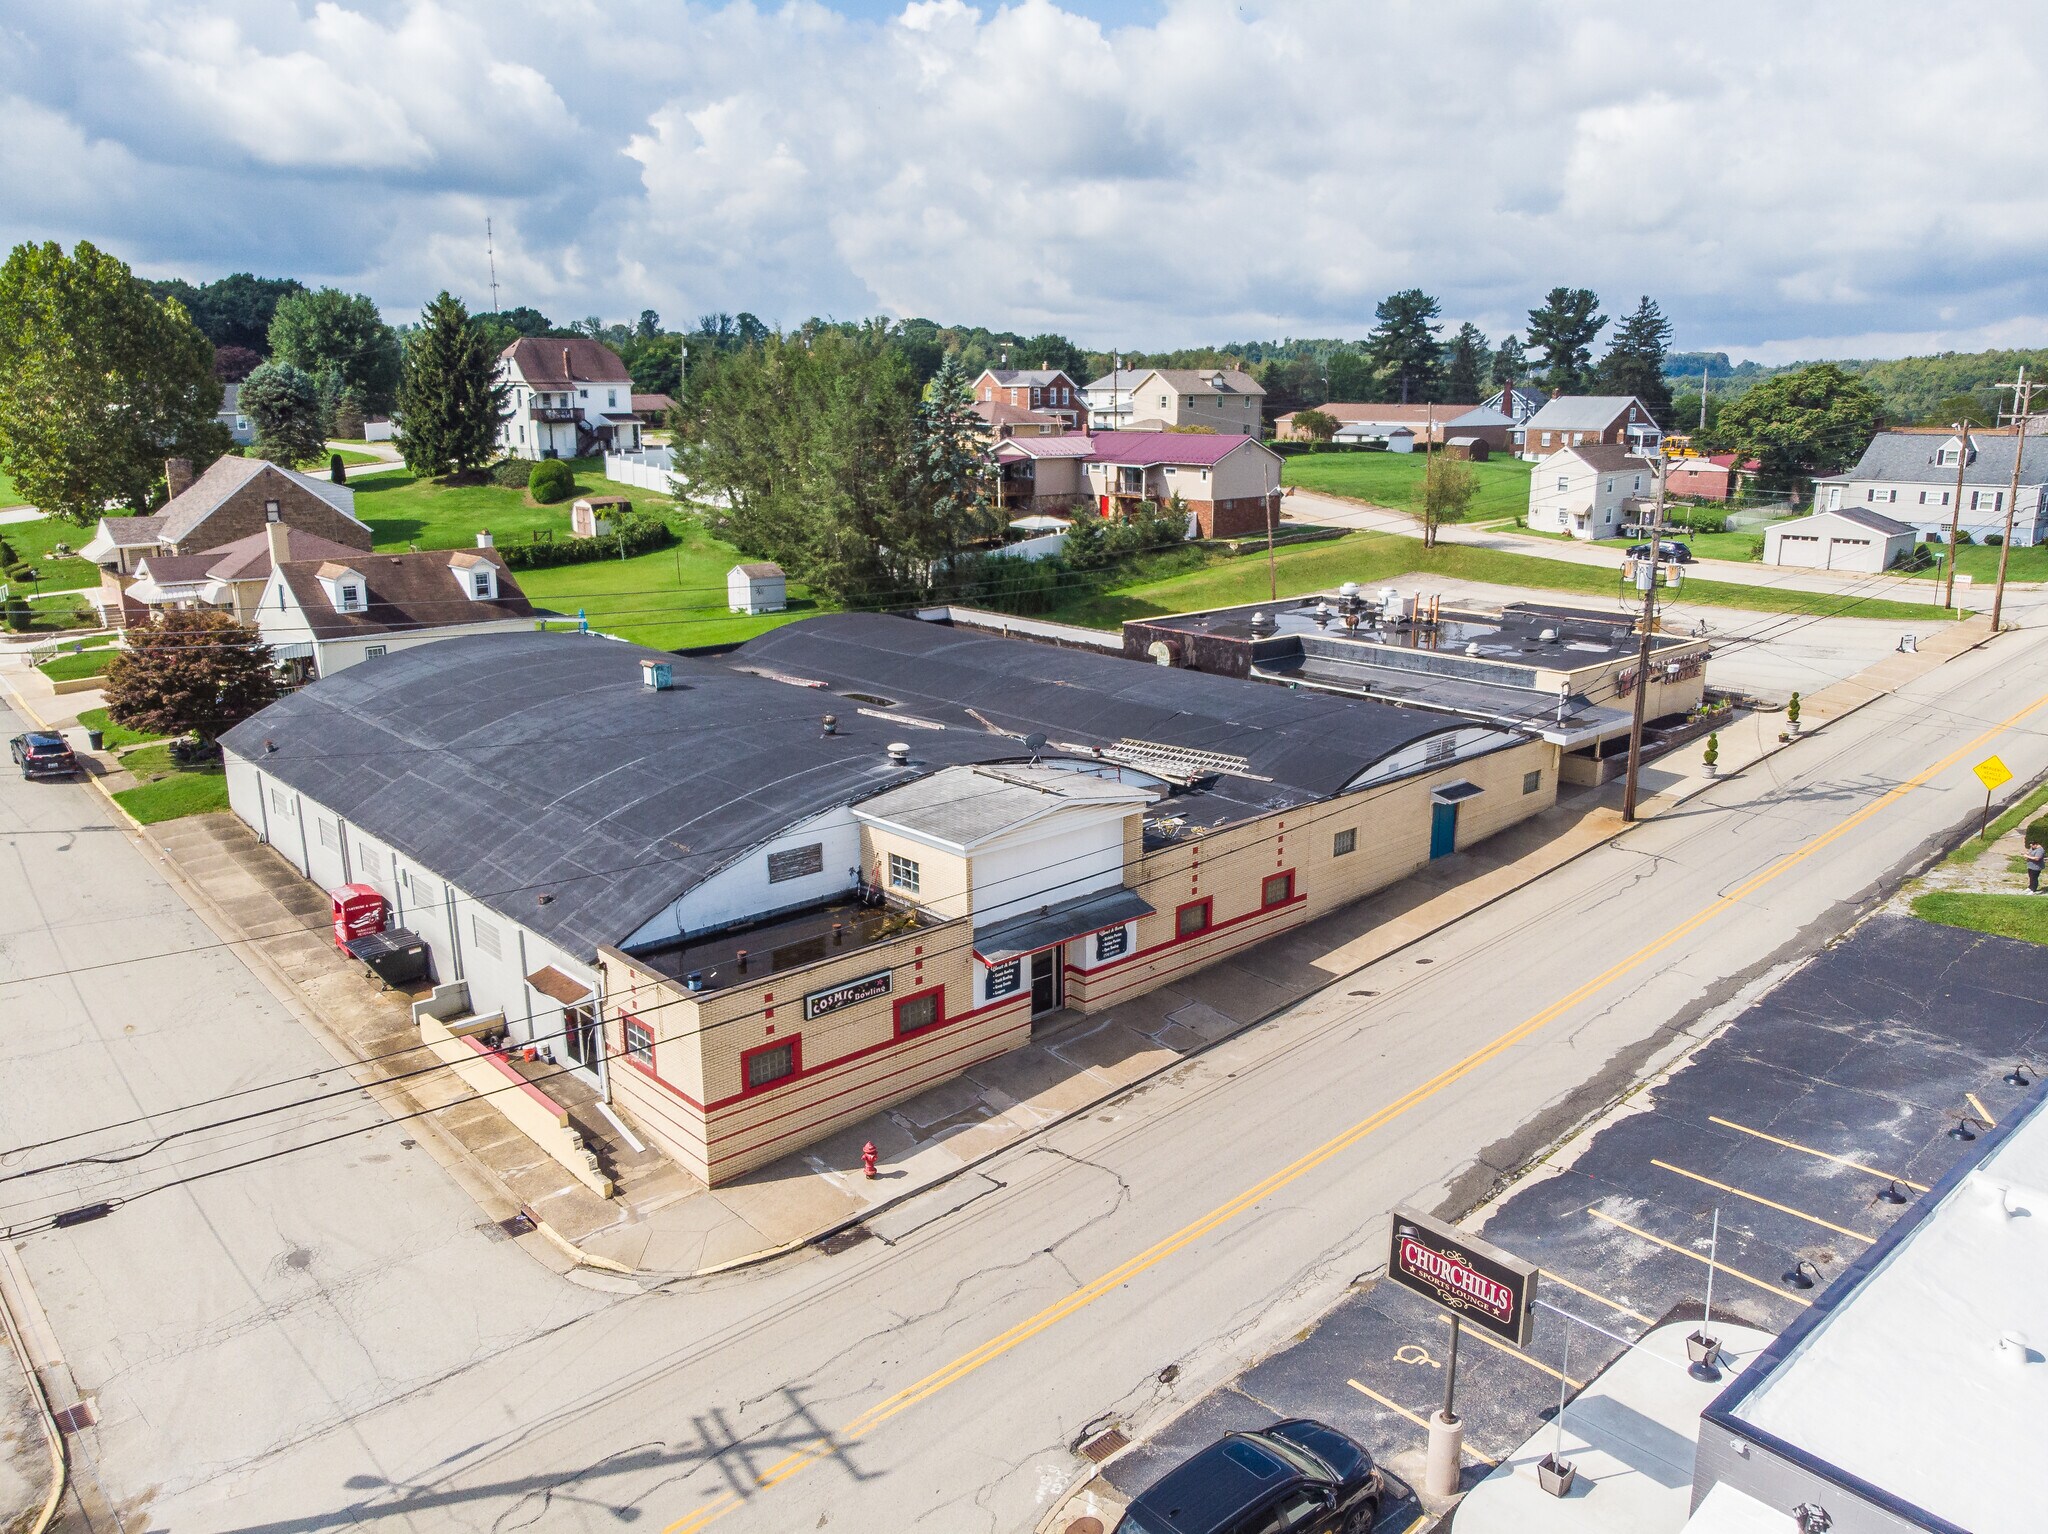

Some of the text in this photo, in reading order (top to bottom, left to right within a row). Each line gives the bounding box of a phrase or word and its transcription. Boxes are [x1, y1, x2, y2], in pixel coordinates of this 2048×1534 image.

[813, 986, 886, 1014] COSMIC Bowling
[1405, 1243, 1508, 1310] CHURCHILLS
[1418, 1270, 1490, 1311] SPORTS LOUNGE
